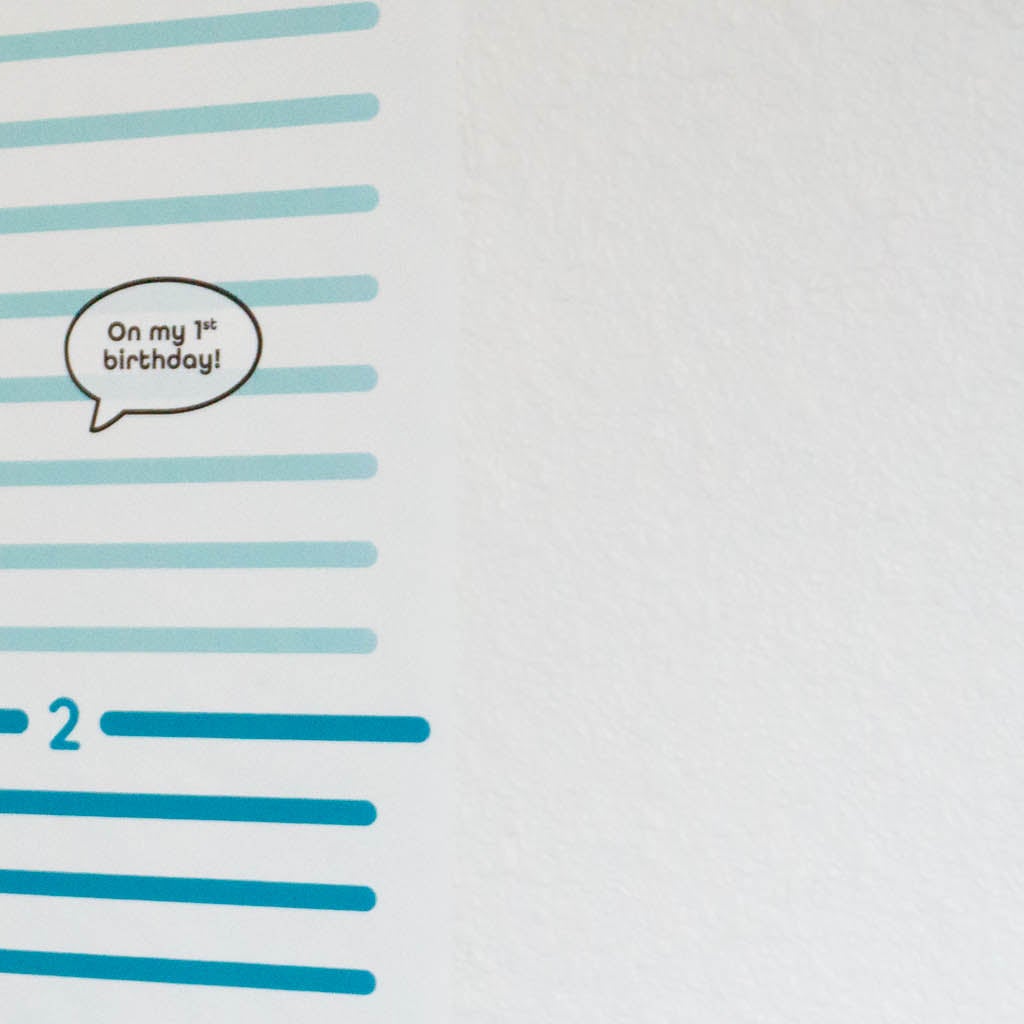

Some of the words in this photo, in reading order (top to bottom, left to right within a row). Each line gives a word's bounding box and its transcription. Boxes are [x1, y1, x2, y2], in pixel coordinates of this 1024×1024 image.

[108, 322, 141, 341] On
[150, 325, 186, 346] my
[194, 318, 218, 339] 1st
[104, 349, 221, 375] birthday!
[49, 697, 81, 750] 2
